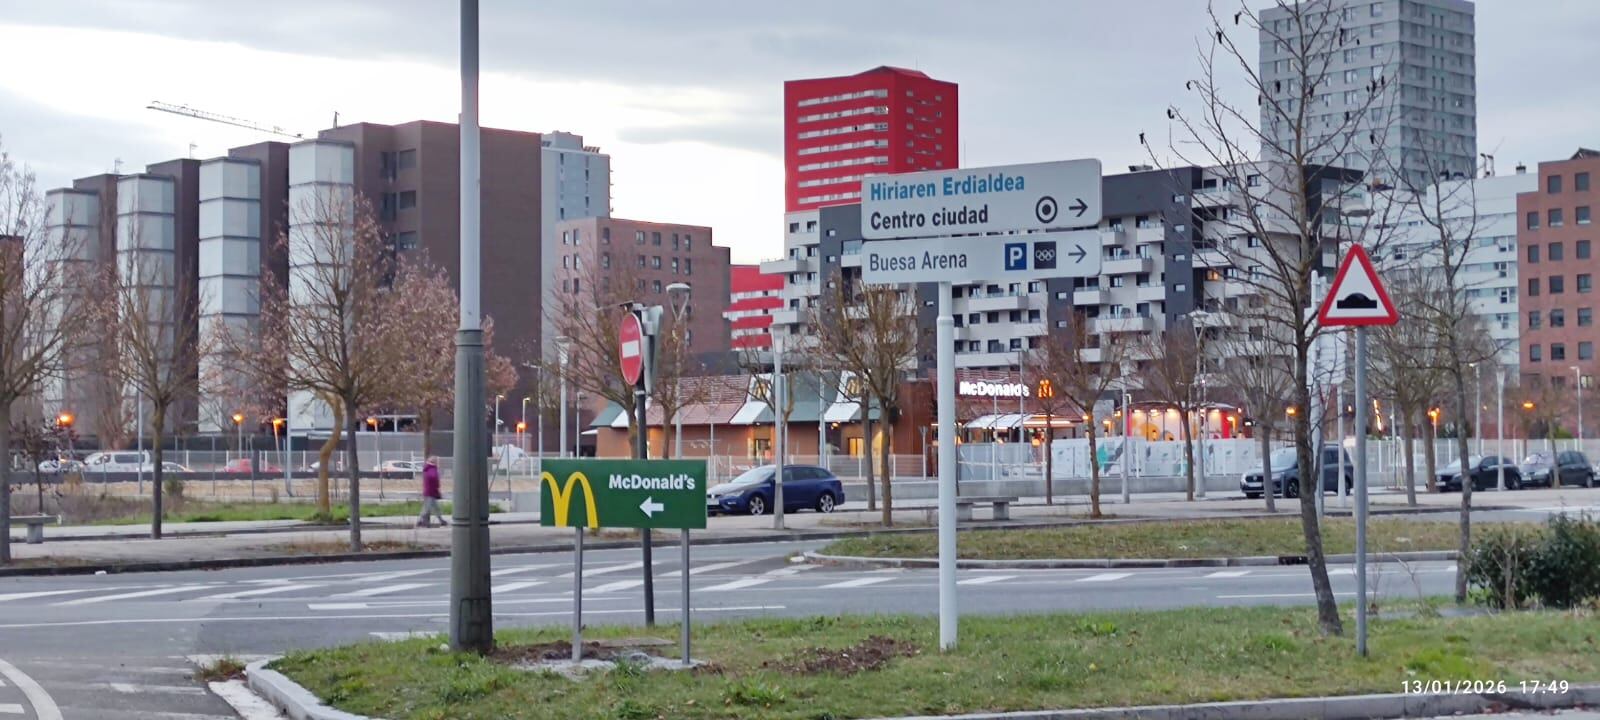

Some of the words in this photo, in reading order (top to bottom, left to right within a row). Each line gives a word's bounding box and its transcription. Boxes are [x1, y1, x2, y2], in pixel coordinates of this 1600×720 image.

[870, 182, 936, 201] Hiriaren
[943, 174, 1025, 196] Erdialdea
[870, 210, 926, 230] Centro
[932, 205, 988, 226] ciudad
[869, 253, 916, 272] Buesa
[921, 251, 967, 269] Arena
[608, 473, 696, 490] McDonald's
